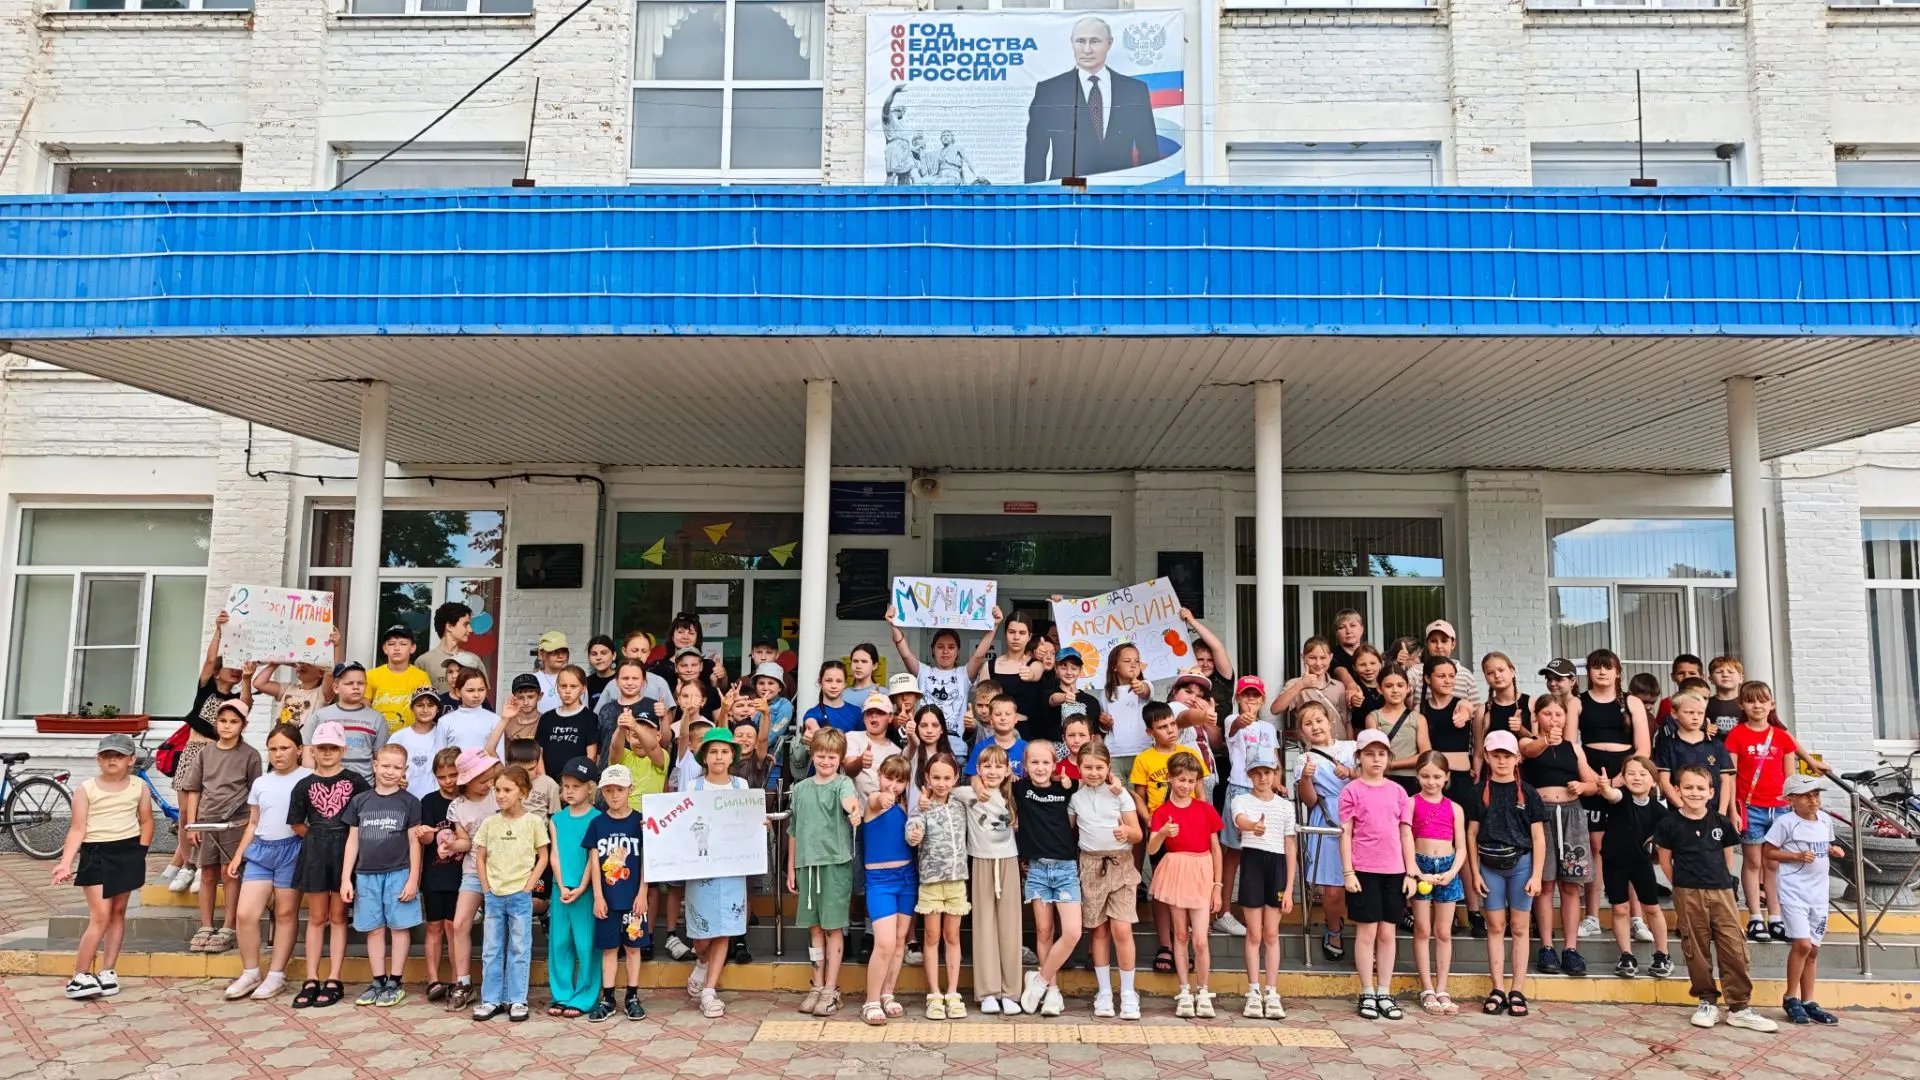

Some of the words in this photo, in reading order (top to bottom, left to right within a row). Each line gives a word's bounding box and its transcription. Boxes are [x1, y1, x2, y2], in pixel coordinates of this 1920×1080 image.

[909, 23, 955, 38] ГОД
[909, 37, 1038, 52] ЕДИНСТВА
[890, 24, 906, 81] 2026
[909, 52, 1024, 67] НАРОДОВ
[909, 67, 1007, 81] РОССИИ
[231, 588, 249, 615] 2
[895, 582, 986, 622] МОЛНИЯ
[1123, 588, 1134, 603] 6
[363, 816, 397, 830] imagine
[597, 836, 639, 858] SHOT
